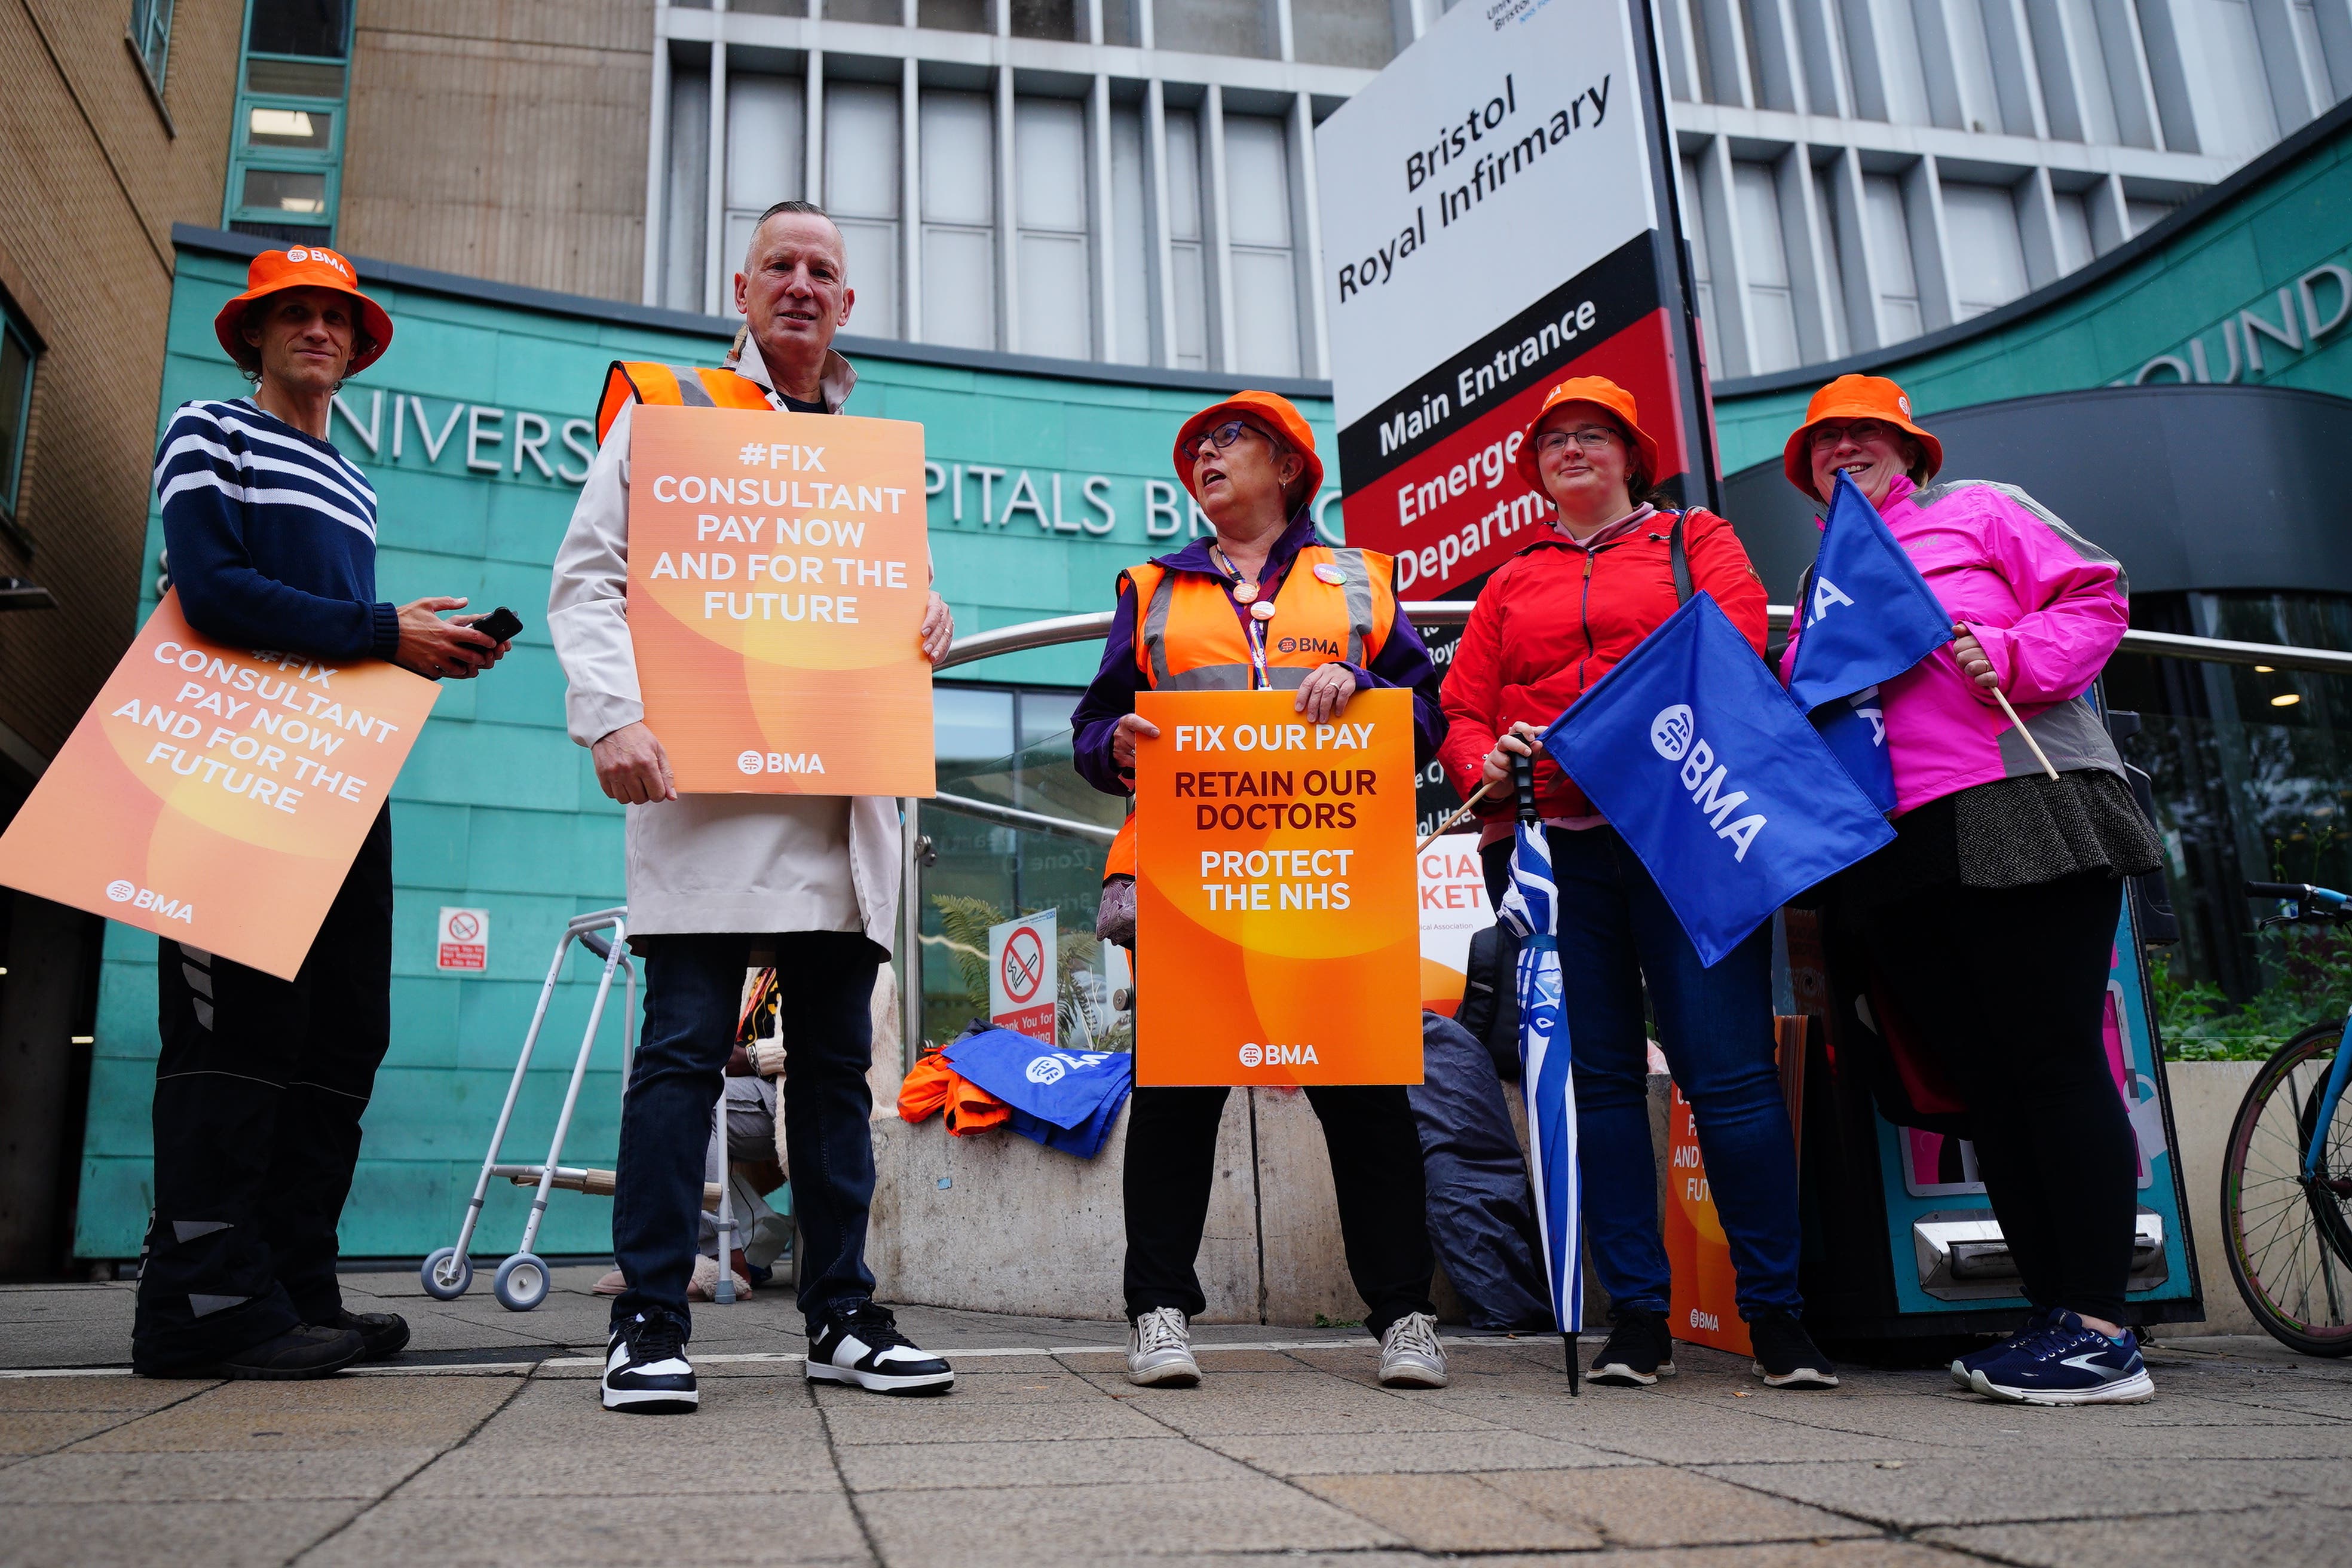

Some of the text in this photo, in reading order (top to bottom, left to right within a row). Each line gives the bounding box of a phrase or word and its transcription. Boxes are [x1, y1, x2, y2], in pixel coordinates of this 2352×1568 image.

[1405, 74, 1517, 193] Bristol
[1339, 74, 1611, 303] Royal Infirmary
[310, 249, 350, 278] BMA
[1379, 300, 1596, 457] Main Entrance
[325, 388, 598, 484] NIVERS
[739, 442, 826, 473] #FIX
[1398, 423, 1533, 527] Emerge
[653, 475, 906, 514] CONSULTANT
[697, 514, 865, 548] PAY NOW
[1396, 490, 1556, 592] Departm
[650, 552, 908, 588] AND FOR THE
[705, 592, 858, 623] FUTURE
[1807, 576, 1855, 629] A
[1300, 638, 1339, 657] BMA
[252, 650, 339, 689] #FIX
[154, 641, 399, 743] CONSULTANT
[176, 682, 344, 757] PAY NOW
[112, 699, 368, 803] AND FOR THE
[1175, 723, 1375, 752] FIX OUR PAY
[146, 742, 304, 814] FUTURE
[767, 753, 825, 774] BMA
[1175, 769, 1377, 797] RETAIN OUR
[1680, 737, 1768, 863] BMA
[1196, 802, 1357, 831] DOCTORS
[1201, 849, 1353, 877] PROTECT
[1418, 854, 1484, 879] CIA
[133, 889, 193, 923] BMA
[1203, 883, 1350, 911] THE NHS
[1022, 1016, 1037, 1028] You
[1040, 1013, 1053, 1025] for
[1266, 1045, 1318, 1065] BMA
[1673, 1146, 1699, 1168] AND
[1699, 1311, 1719, 1333] BMA
